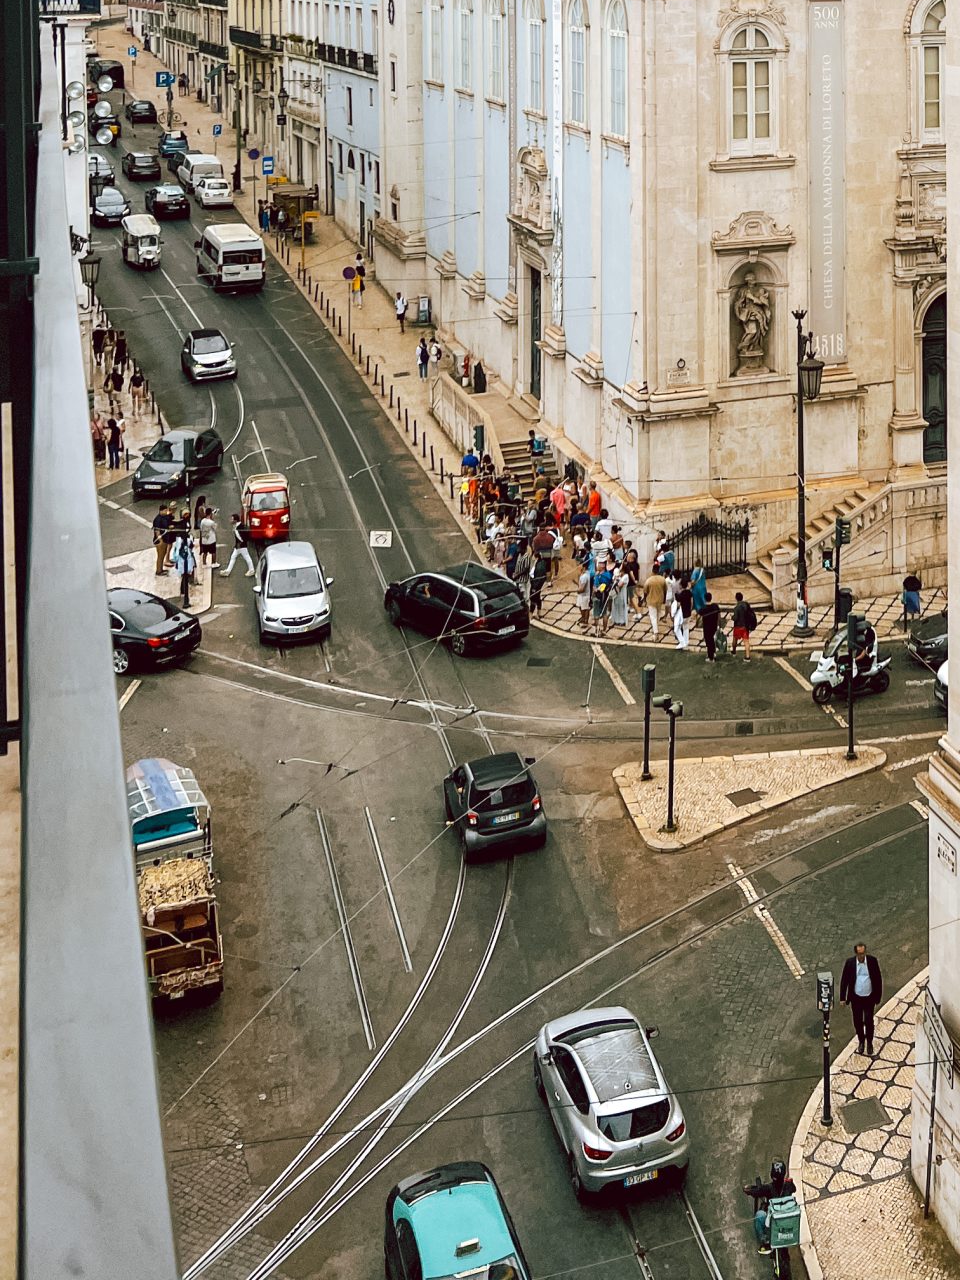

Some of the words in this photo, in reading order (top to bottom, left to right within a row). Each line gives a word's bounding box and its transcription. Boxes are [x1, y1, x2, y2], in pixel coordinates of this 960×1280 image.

[159, 74, 167, 83] P
[814, 333, 844, 348] 1518
[814, 344, 844, 358] 2018
